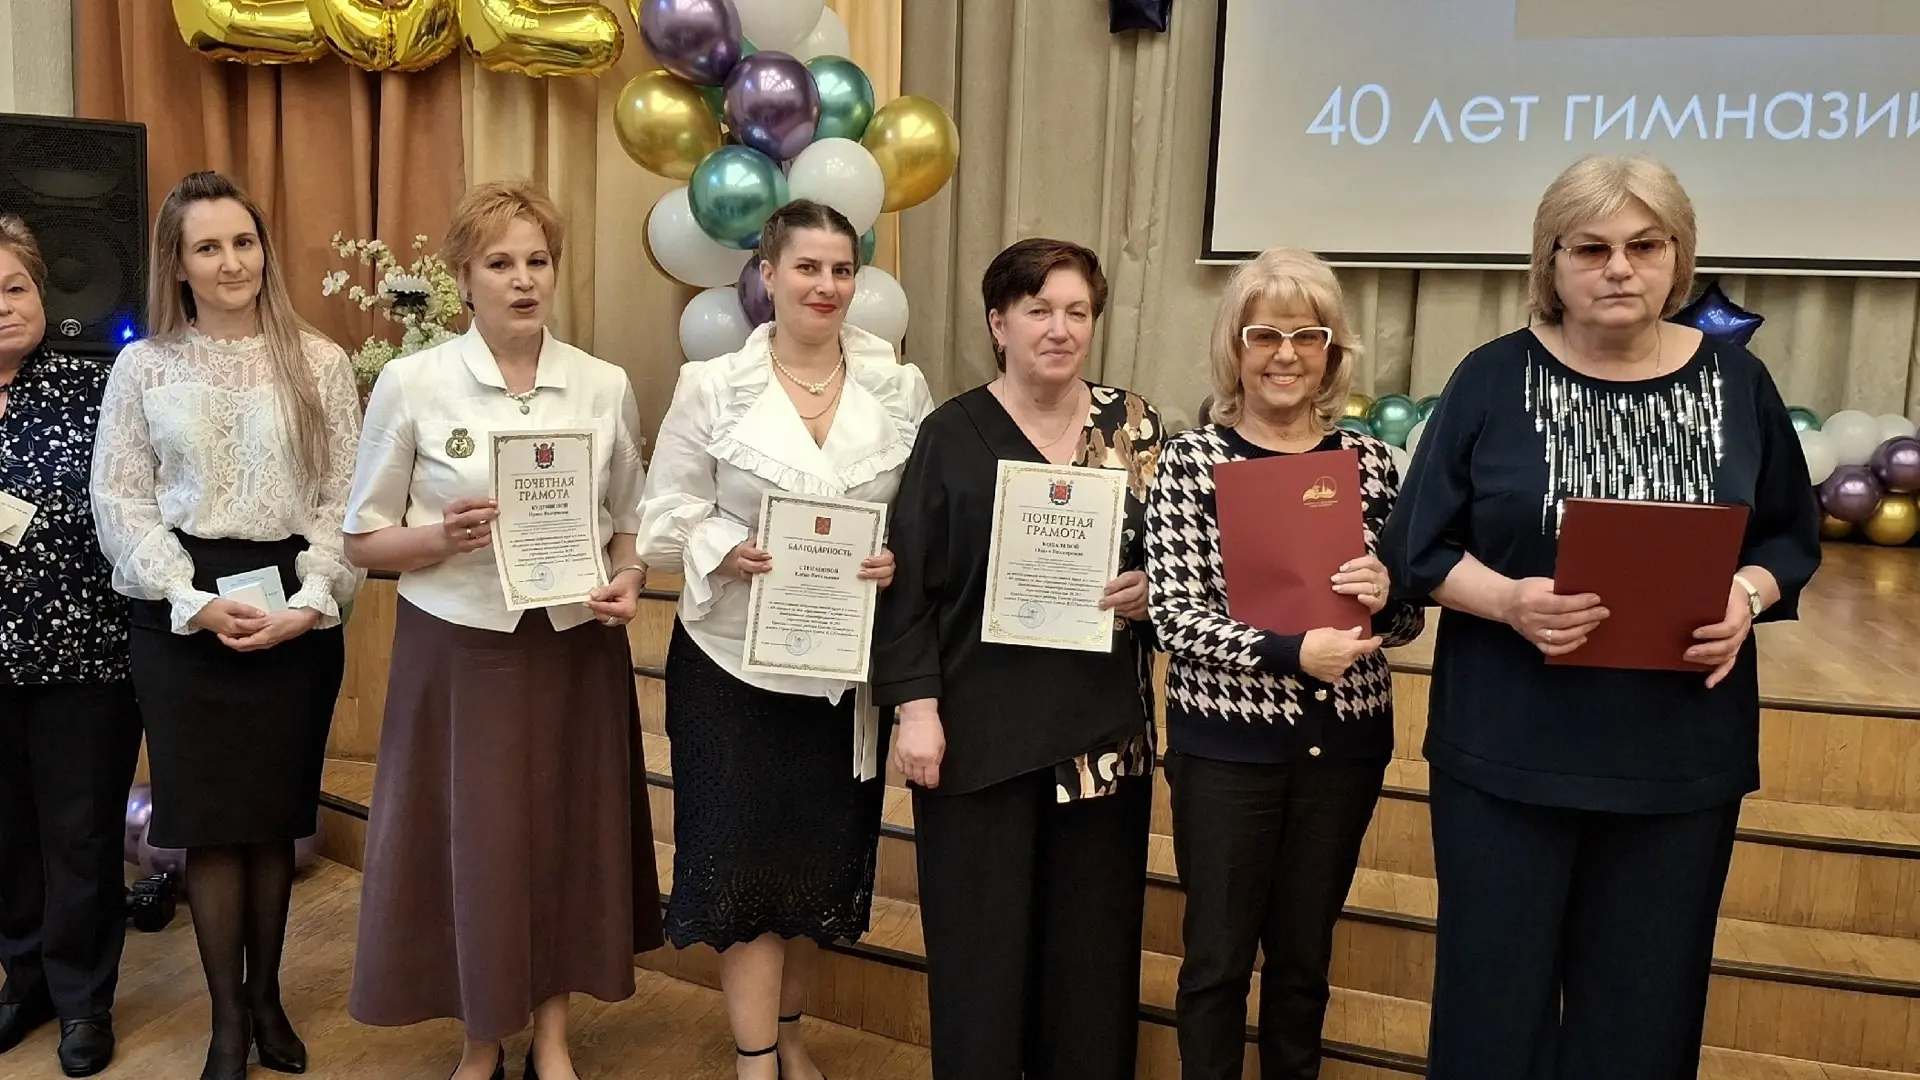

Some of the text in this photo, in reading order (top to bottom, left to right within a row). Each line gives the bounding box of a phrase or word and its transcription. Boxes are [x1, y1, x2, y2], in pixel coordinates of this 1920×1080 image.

[1306, 83, 1390, 145] 40
[1413, 95, 1539, 142] лет
[514, 476, 575, 490] ПОЧЕТНАЯ
[519, 489, 570, 501] ГРАМОТА
[1022, 512, 1095, 528] ПОЧЕТНАЯ
[1026, 525, 1086, 540] ГРАМОТА
[788, 543, 852, 557] БЛАГОДАРНОСТЬ
